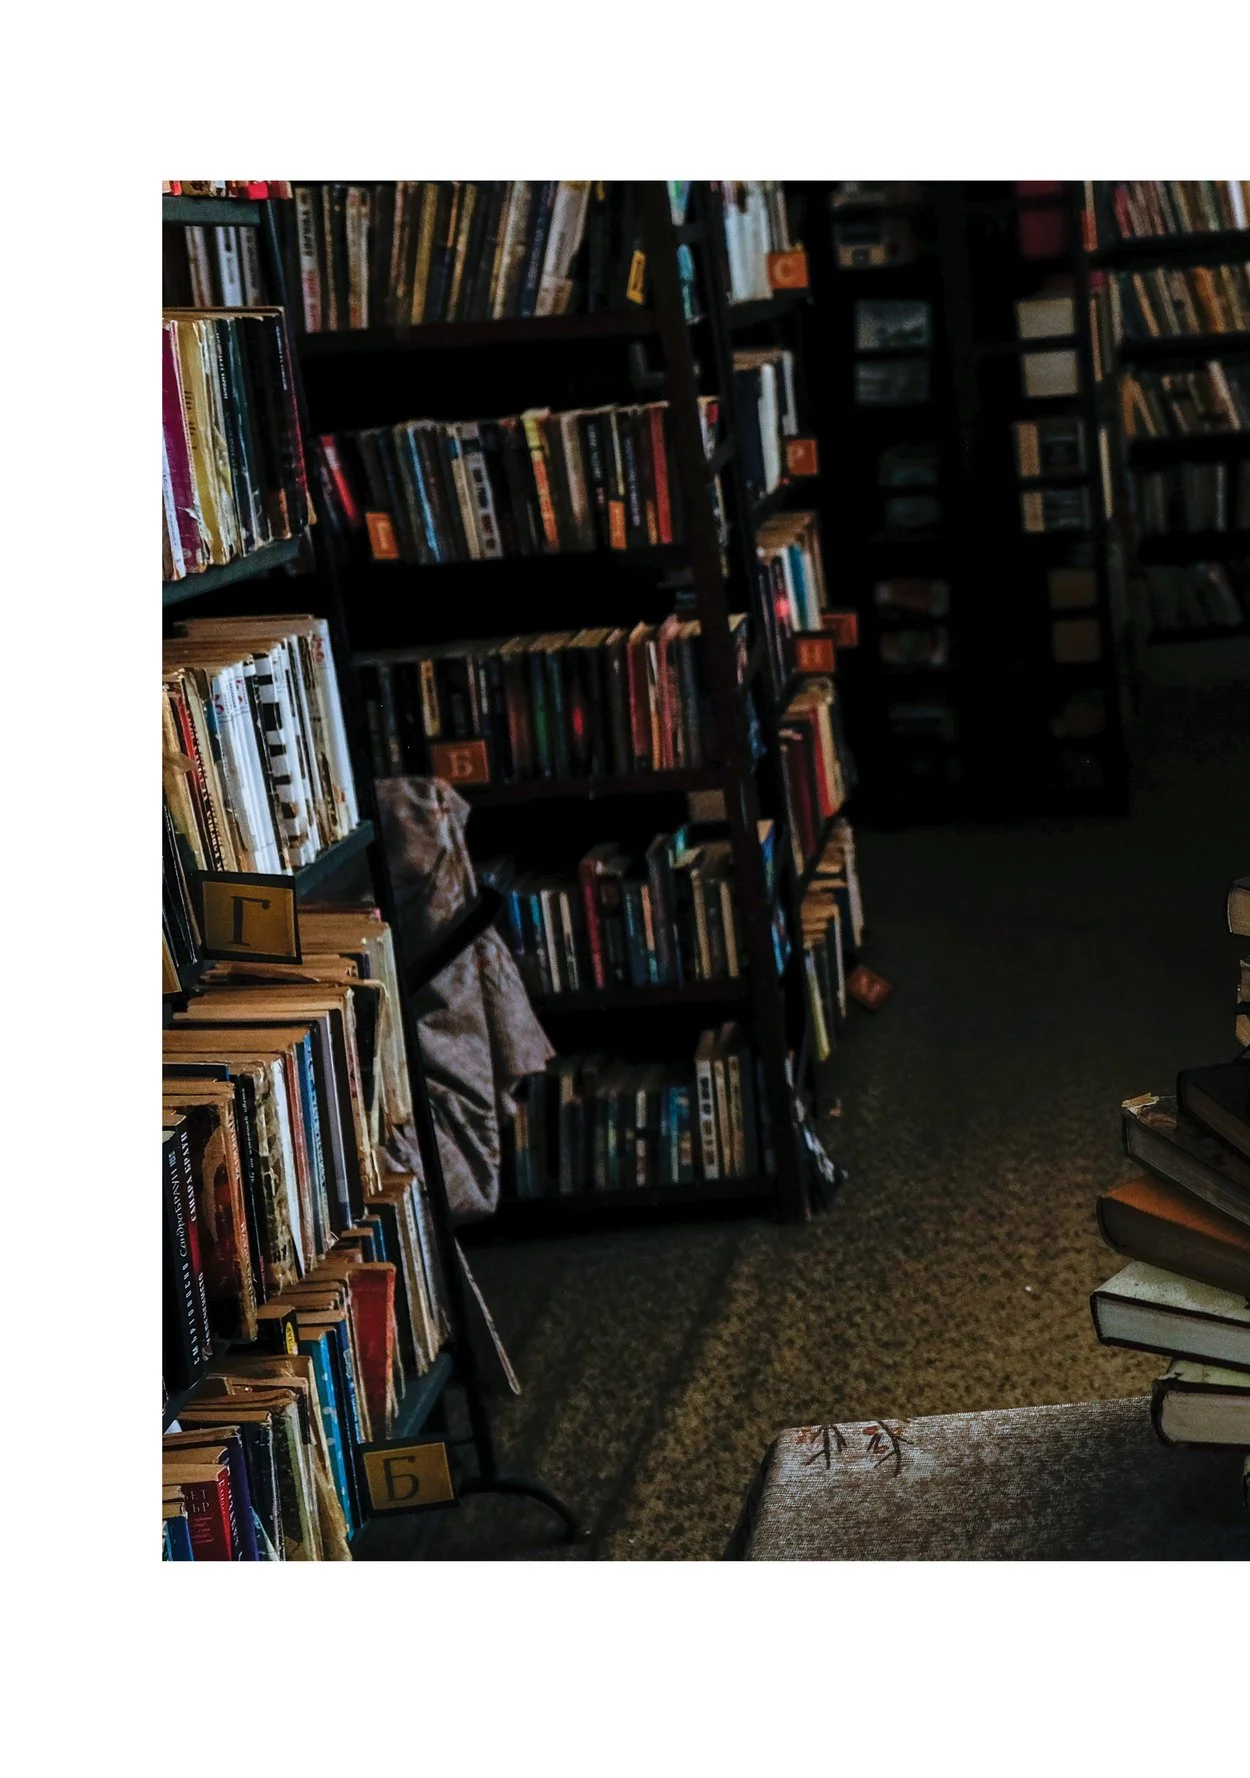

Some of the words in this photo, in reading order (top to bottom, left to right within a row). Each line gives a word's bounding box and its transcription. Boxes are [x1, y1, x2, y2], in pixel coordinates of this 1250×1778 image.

[450, 750, 474, 780] Б
[228, 894, 272, 947] Г
[180, 1131, 192, 1174] БРАУН
[170, 1168, 182, 1213] БРАУН
[186, 1174, 197, 1222] САНДРА
[176, 1212, 188, 1257] Сандра
[383, 1456, 419, 1502] Б
